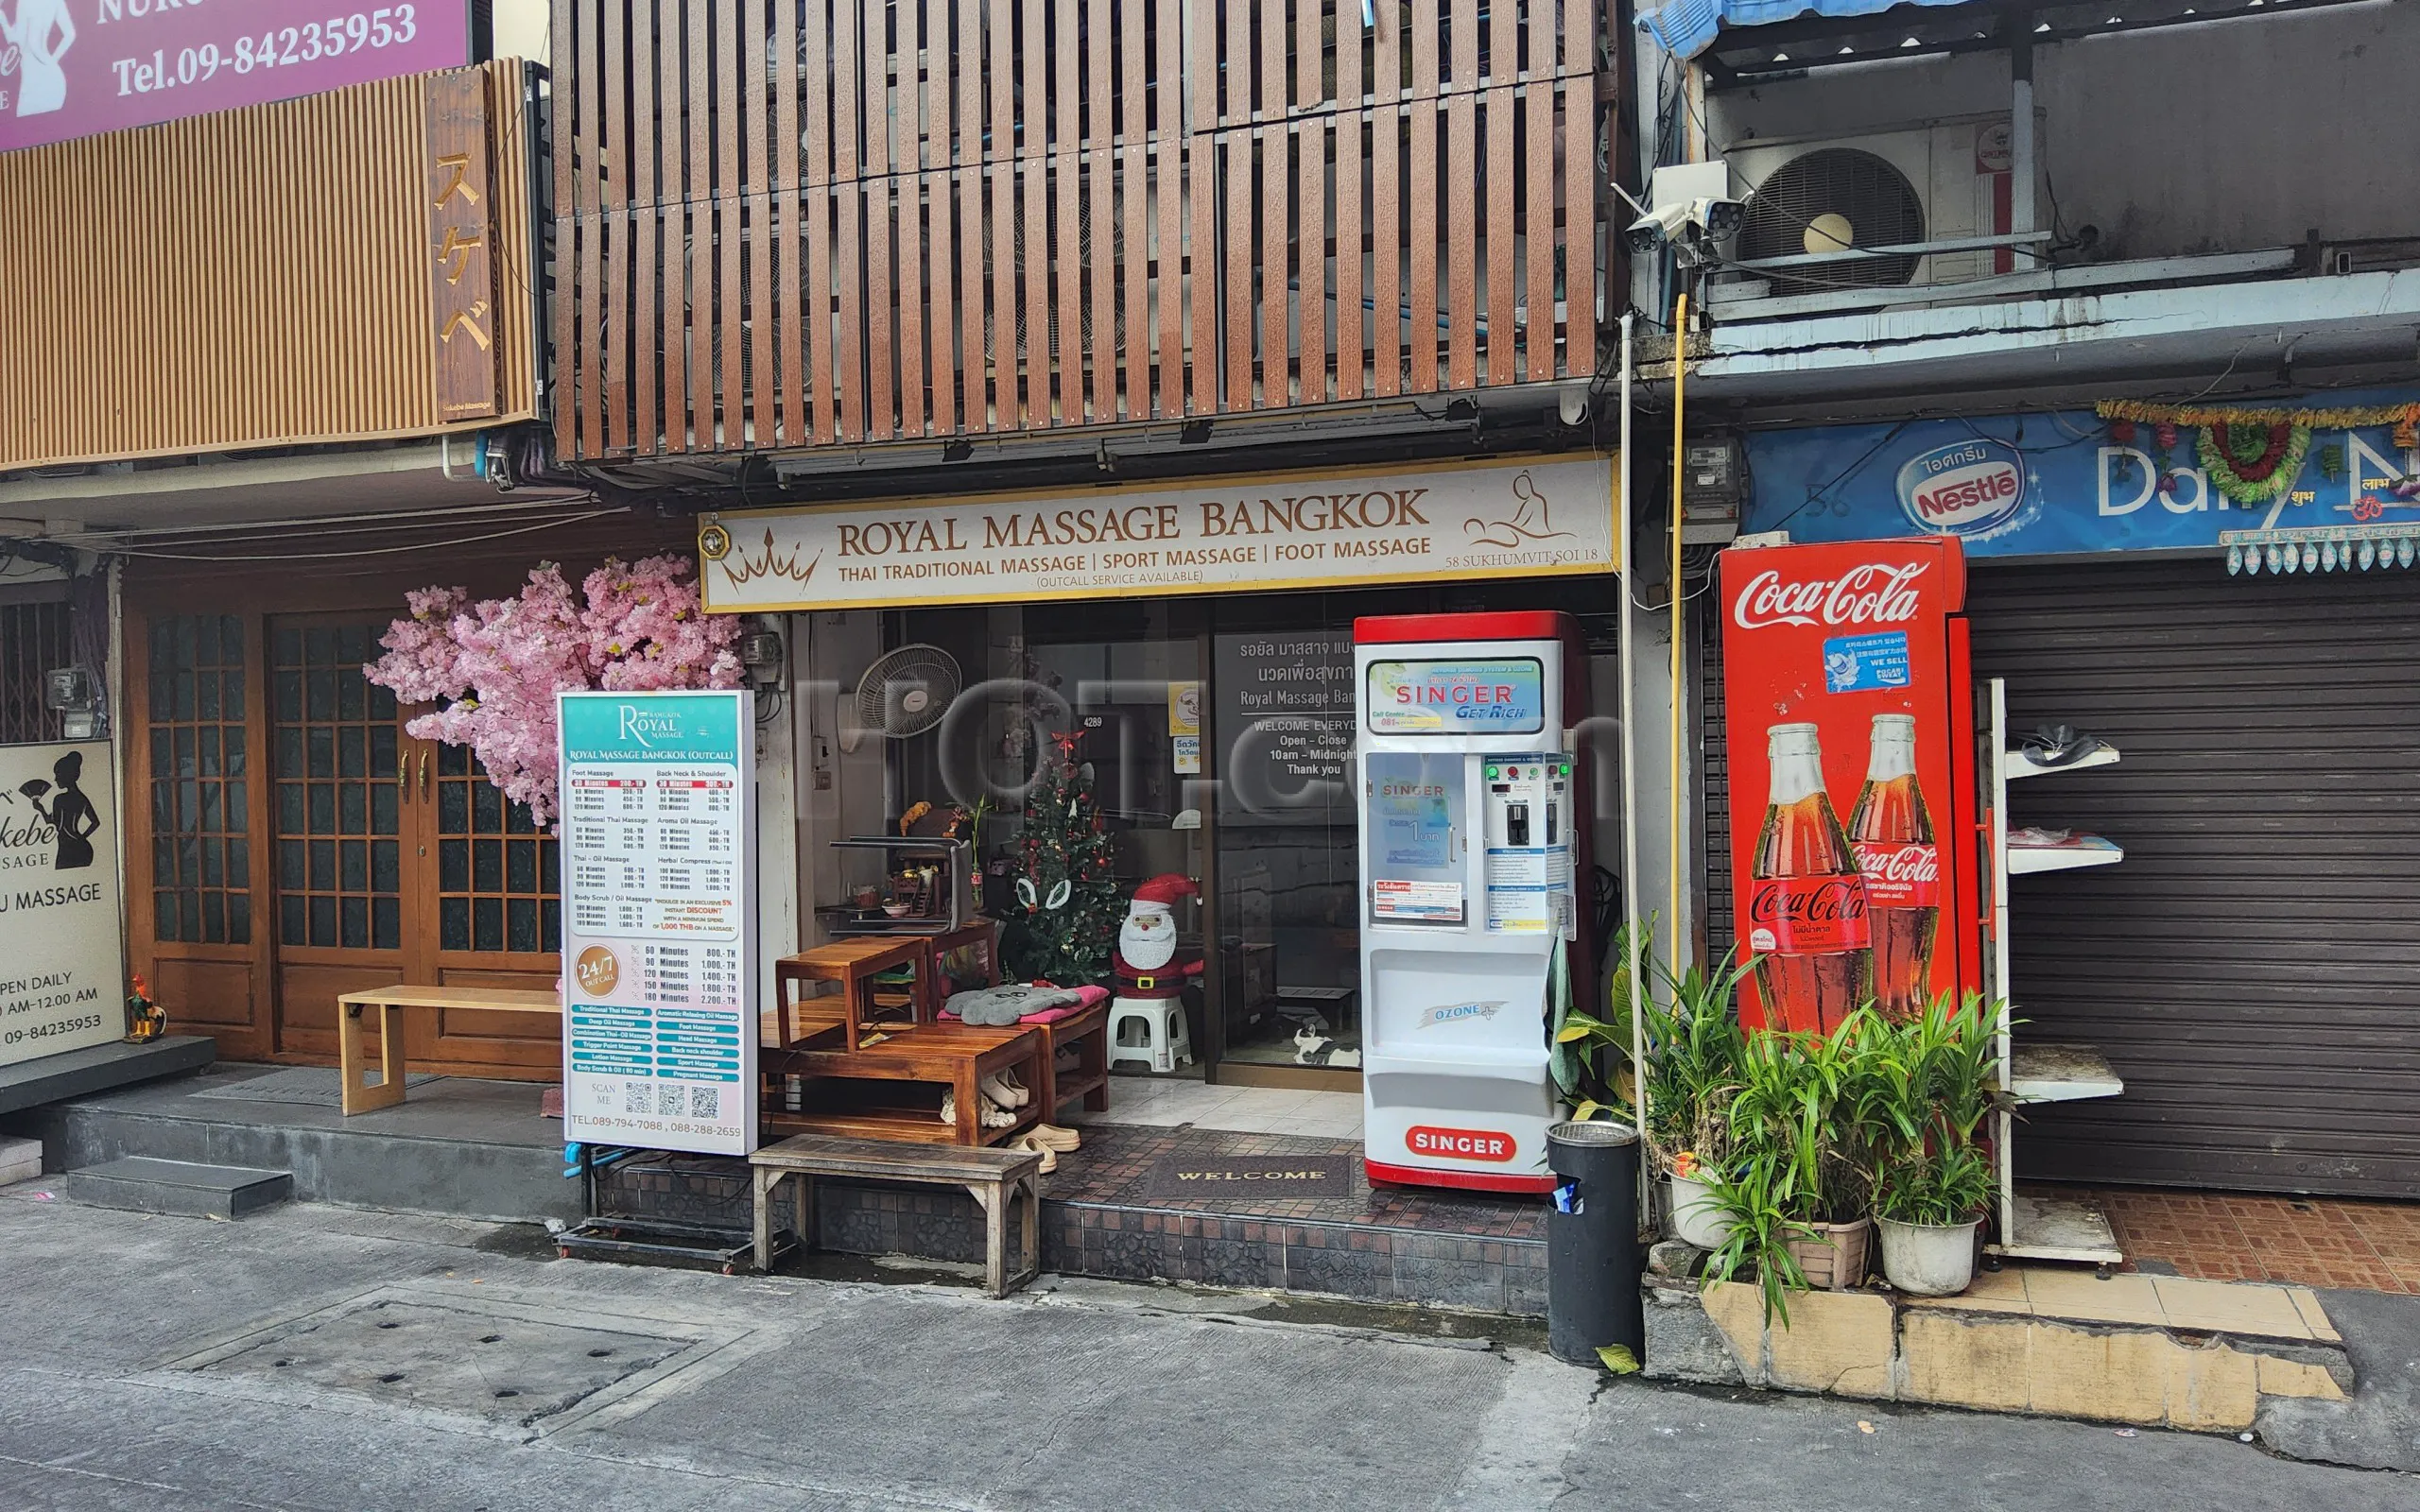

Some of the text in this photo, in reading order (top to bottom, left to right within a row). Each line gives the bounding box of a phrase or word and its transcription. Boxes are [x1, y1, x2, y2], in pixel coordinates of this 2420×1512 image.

[112, 4, 417, 96] Tel.09-84235953
[434, 152, 489, 352] スケベ
[1921, 446, 1987, 474] ไอศกรีม
[2361, 478, 2391, 490] लाभ
[1917, 470, 2016, 518] Nestlé
[838, 489, 1430, 557] ROYAL MASSAGE BANGKOK
[838, 537, 1431, 582] THAI TRADITIONAL MASSAGE SPORT MASSAGE FOOT MASSAGE
[1445, 548, 1599, 567] 58 SUKHUMVIT SOI 18
[1037, 570, 1203, 589] (OUTCALL SERVICE AVAILABLE)
[1734, 561, 1931, 629] Coca-Cola
[1278, 642, 1329, 656] มาสสาจ
[1870, 656, 1908, 666] WE SELL
[1240, 690, 1272, 709] Royal
[1277, 690, 1329, 708] Massage
[1396, 684, 1513, 705] SINGER
[1455, 705, 1527, 719] GET RICH
[617, 705, 677, 747] ROYAL
[1084, 717, 1102, 728] 4289
[1254, 721, 1309, 732] WELCOME
[1280, 736, 1306, 747] Open
[1318, 734, 1347, 746] Close
[570, 750, 734, 760] ROYAL MASSAGE BANGKOK (OUTCALL)
[1270, 750, 1299, 761] 10am
[1309, 749, 1357, 763] Midnight
[1287, 765, 1341, 777] Thank you
[1383, 785, 1444, 796] SINGER
[2, 852, 50, 869] SAGE
[15, 883, 102, 912] MASSAGE
[1751, 880, 1867, 923] Coca-Cola
[686, 906, 723, 915] DISCOUNT
[646, 946, 655, 954] 60
[660, 946, 688, 955] Minutes
[727, 949, 736, 958] TH
[579, 955, 613, 980] 24/7
[646, 957, 736, 970] 90 Minutes TH
[585, 973, 614, 988] OUT CALL
[644, 969, 736, 982] 120 Minutes TH
[0, 971, 73, 996] PEN DAILY
[644, 981, 736, 994] 150 Minutes TH
[75, 987, 98, 1003] AM
[645, 992, 736, 1005] 180 Minutes TH
[1435, 1004, 1480, 1021] OZONE
[4, 1014, 102, 1045] 09-84235953
[693, 1036, 717, 1044] Massage
[700, 1073, 723, 1081] Massage
[592, 1083, 615, 1093] SCAN
[596, 1095, 612, 1105] ME
[572, 1114, 740, 1137] TEL.089-794-7088 088-288-2659
[1415, 1133, 1503, 1155] SINGER
[1177, 1171, 1327, 1181] WELCOME
